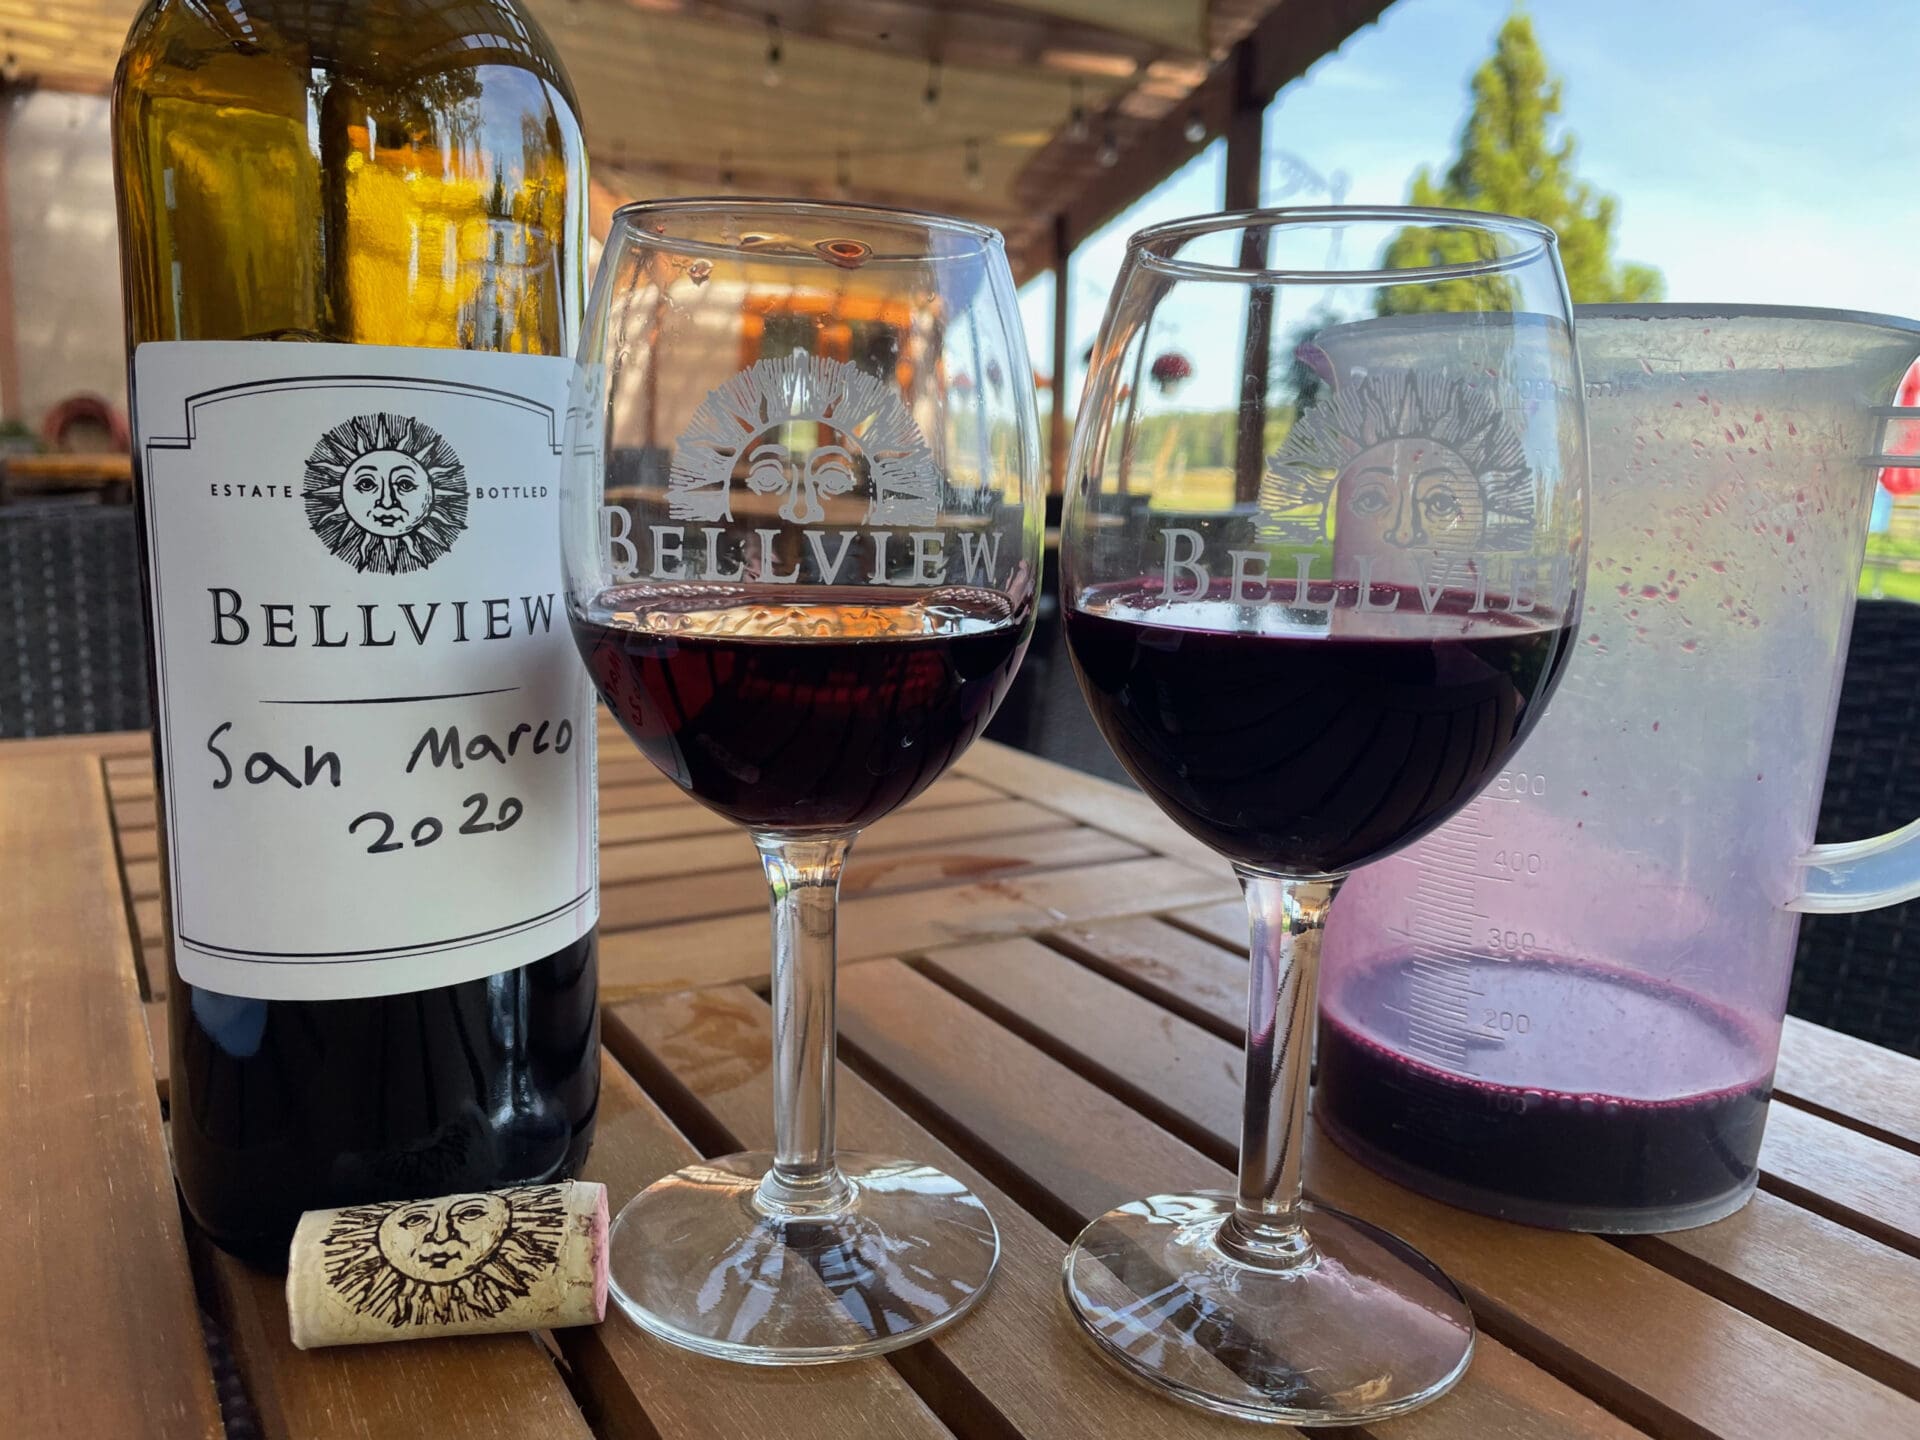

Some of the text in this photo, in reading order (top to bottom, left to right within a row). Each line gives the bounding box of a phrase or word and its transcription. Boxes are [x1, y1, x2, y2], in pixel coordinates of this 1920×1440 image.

[210, 484, 549, 500] ESTATE BOTTLED
[599, 505, 1003, 586] BELLVIEW
[206, 587, 556, 648] BELLVIEW
[206, 718, 573, 790] San Marco
[1497, 771, 1547, 797] 500
[348, 792, 524, 854] 2020
[1493, 848, 1542, 875] 400
[1486, 927, 1536, 953] 300
[1482, 1008, 1531, 1035] 200
